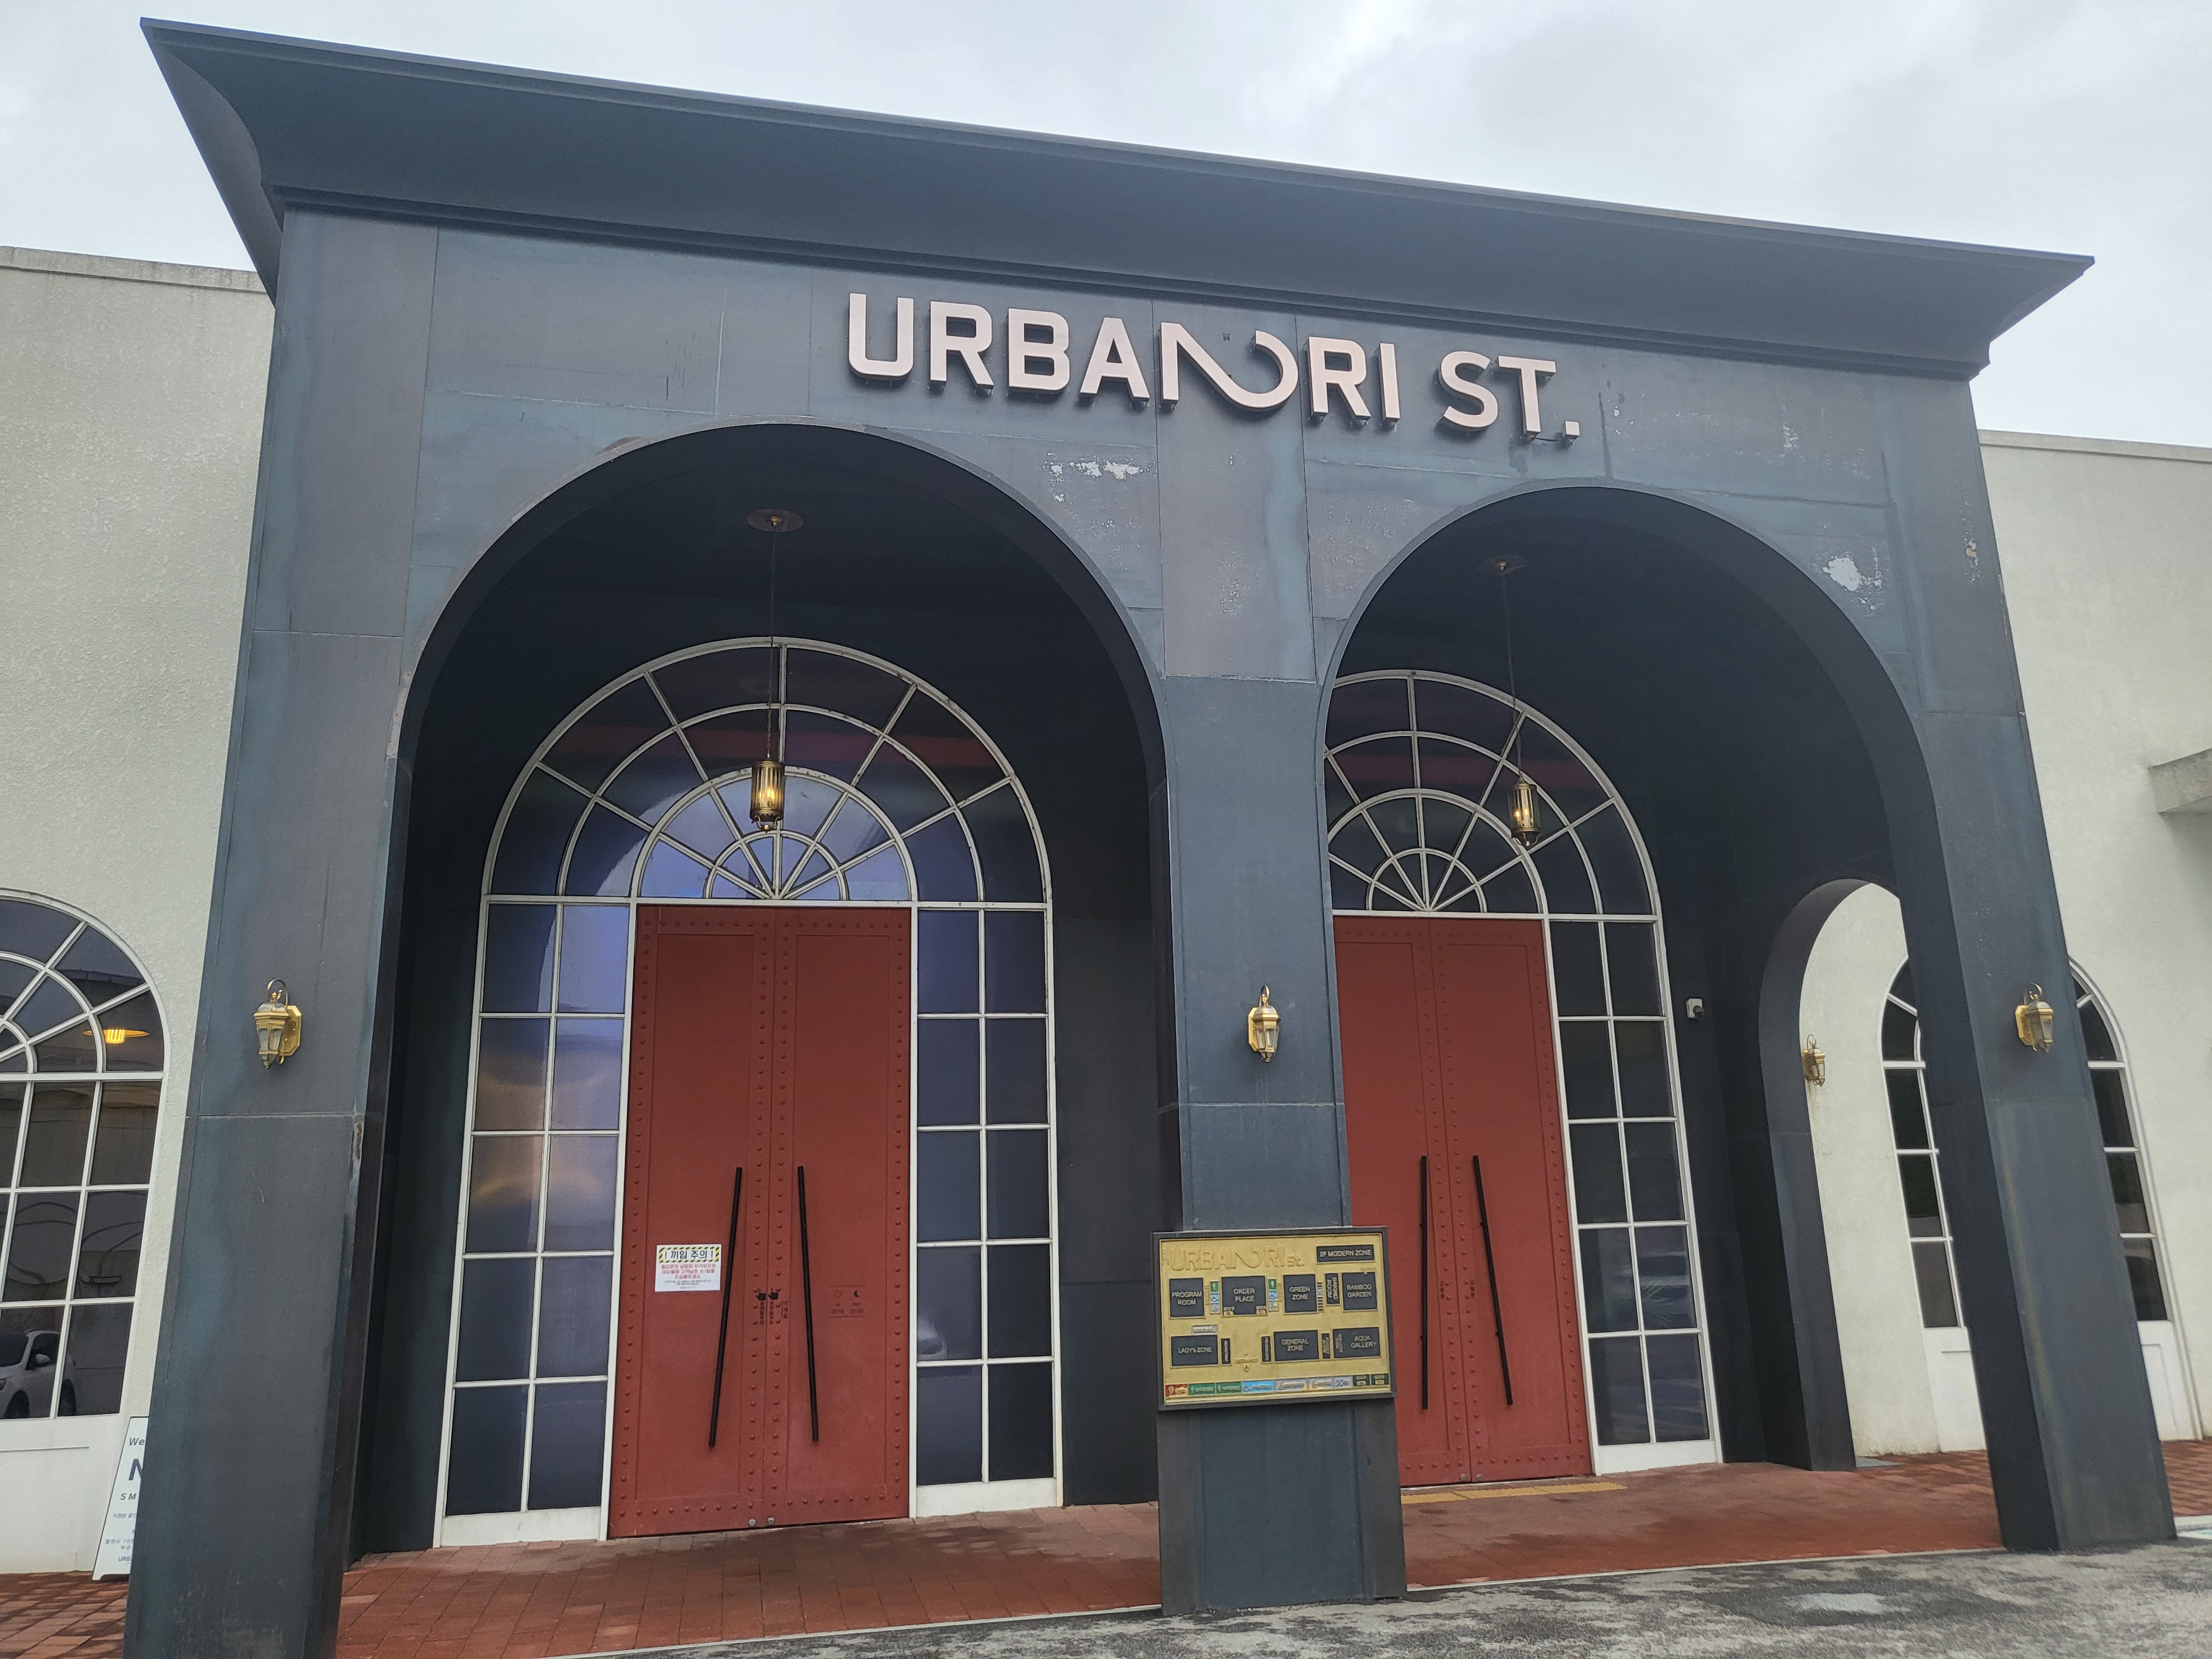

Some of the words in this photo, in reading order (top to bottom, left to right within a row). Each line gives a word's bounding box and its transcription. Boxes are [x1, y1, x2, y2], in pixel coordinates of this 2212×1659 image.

[1439, 351, 1580, 444] ST.
[670, 1250, 687, 1259] 끼임
[691, 1250, 707, 1259] 주의
